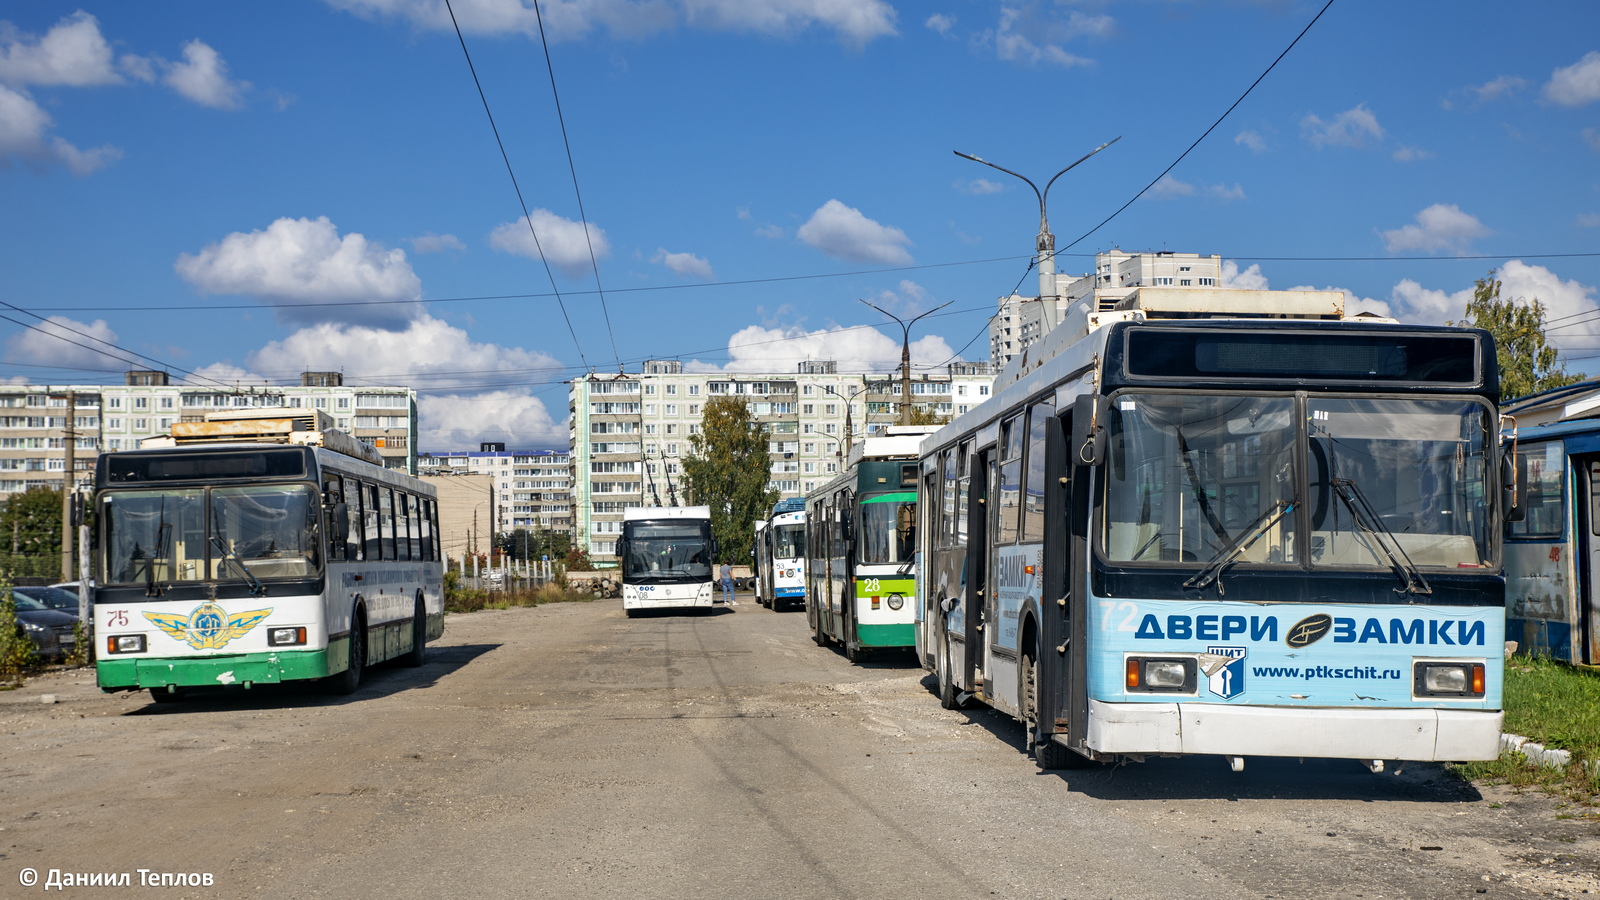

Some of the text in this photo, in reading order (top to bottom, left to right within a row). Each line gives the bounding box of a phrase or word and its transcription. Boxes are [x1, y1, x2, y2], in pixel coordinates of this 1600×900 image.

[1549, 546, 1560, 563] 48
[1000, 555, 1026, 587] ЗАМКИ
[864, 578, 880, 592] 28
[107, 610, 128, 627] 75
[1098, 601, 1138, 632] 72
[1135, 614, 1485, 646] ДВЕРИ ЗАМКИ
[1253, 665, 1400, 681] www.ptkschit.ru
